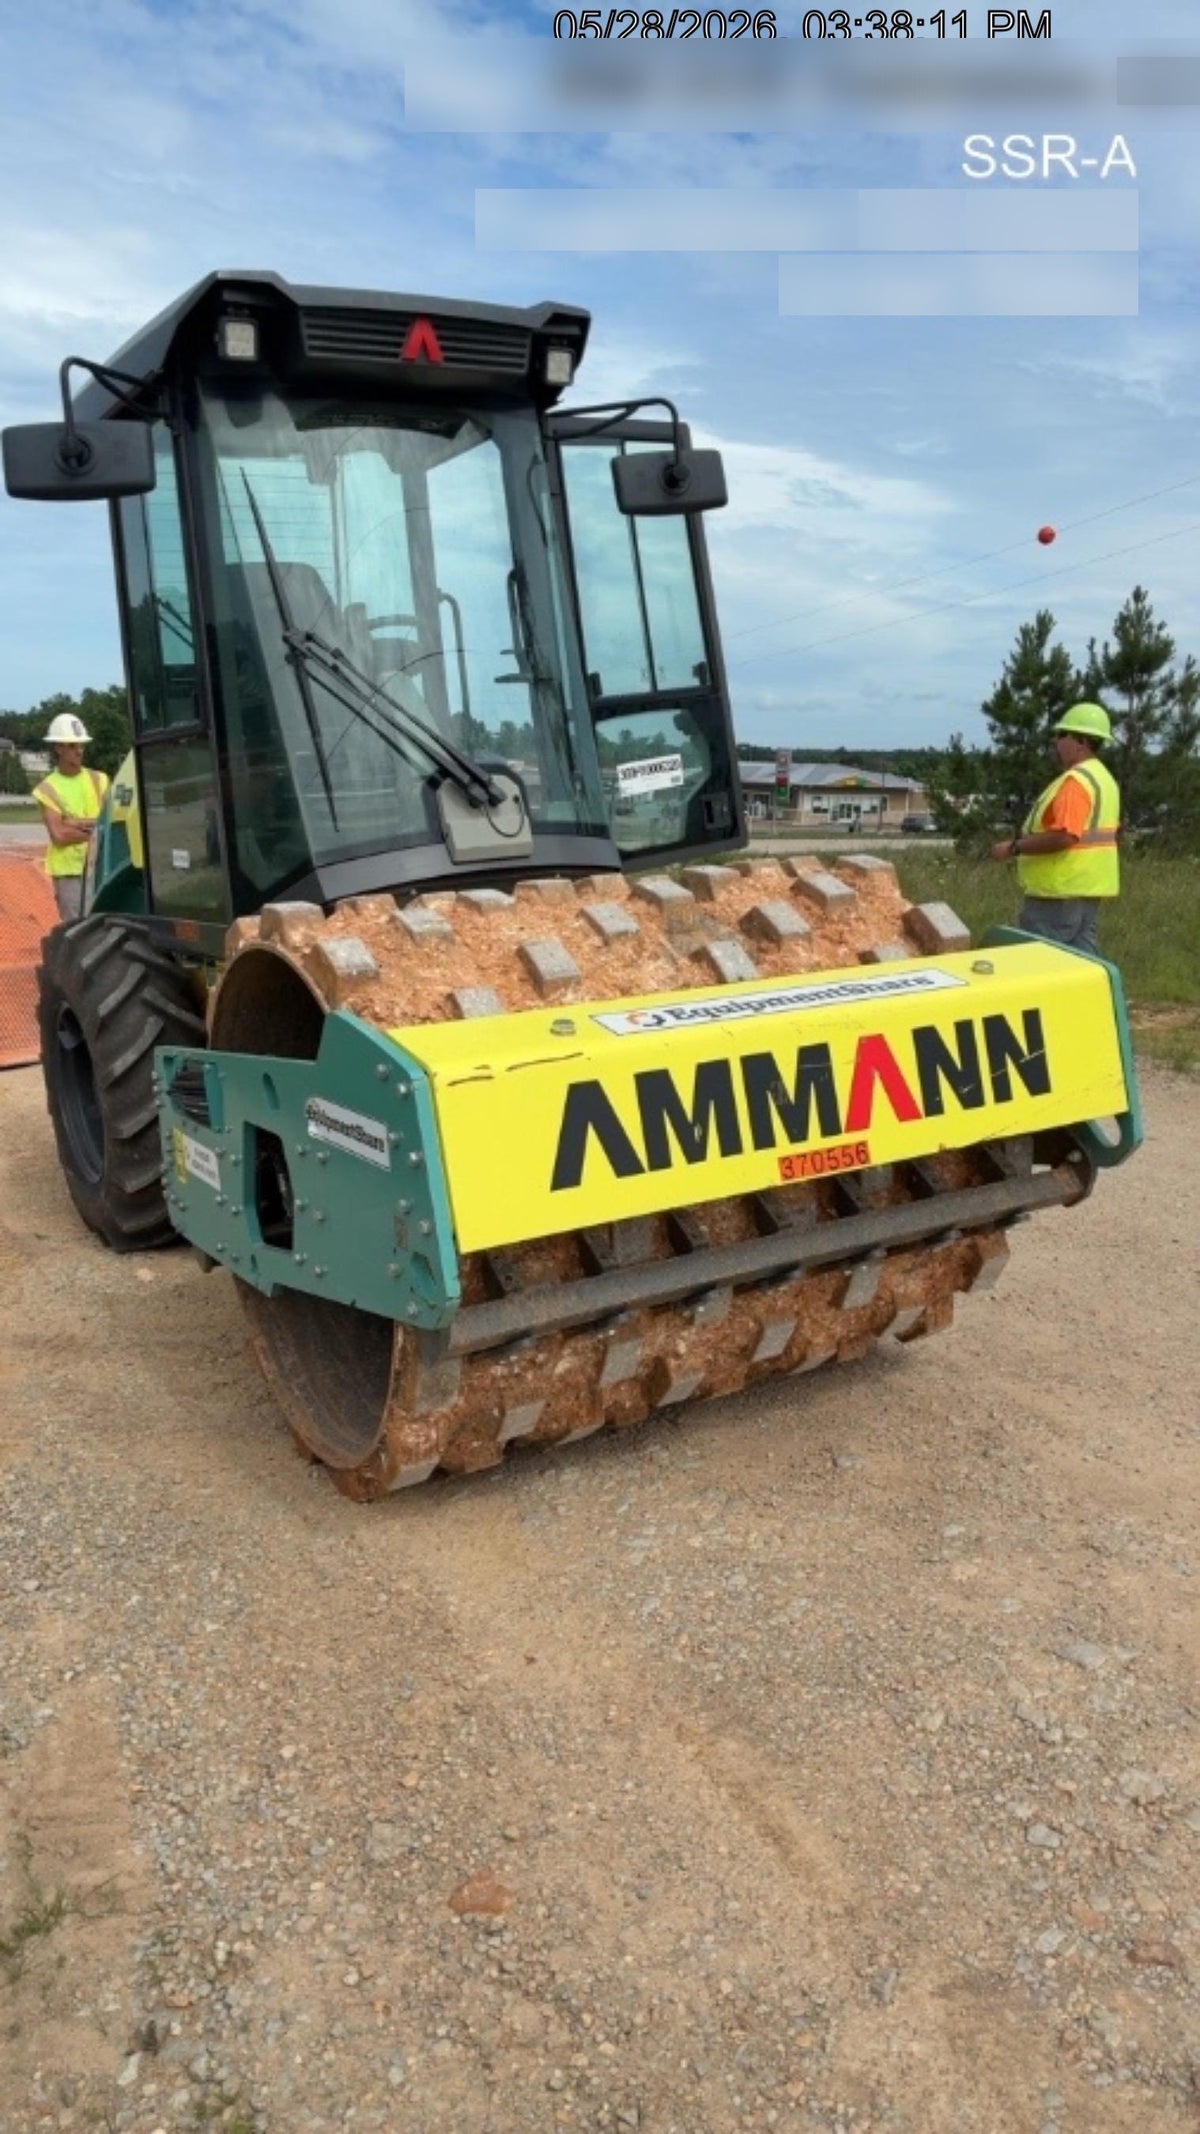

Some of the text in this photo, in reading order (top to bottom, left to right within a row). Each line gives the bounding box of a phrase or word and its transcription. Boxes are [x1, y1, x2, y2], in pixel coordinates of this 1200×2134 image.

[662, 976, 936, 1022] EquipmentShare
[550, 1008, 1053, 1192] AMMANN
[781, 1142, 869, 1180] 370556
